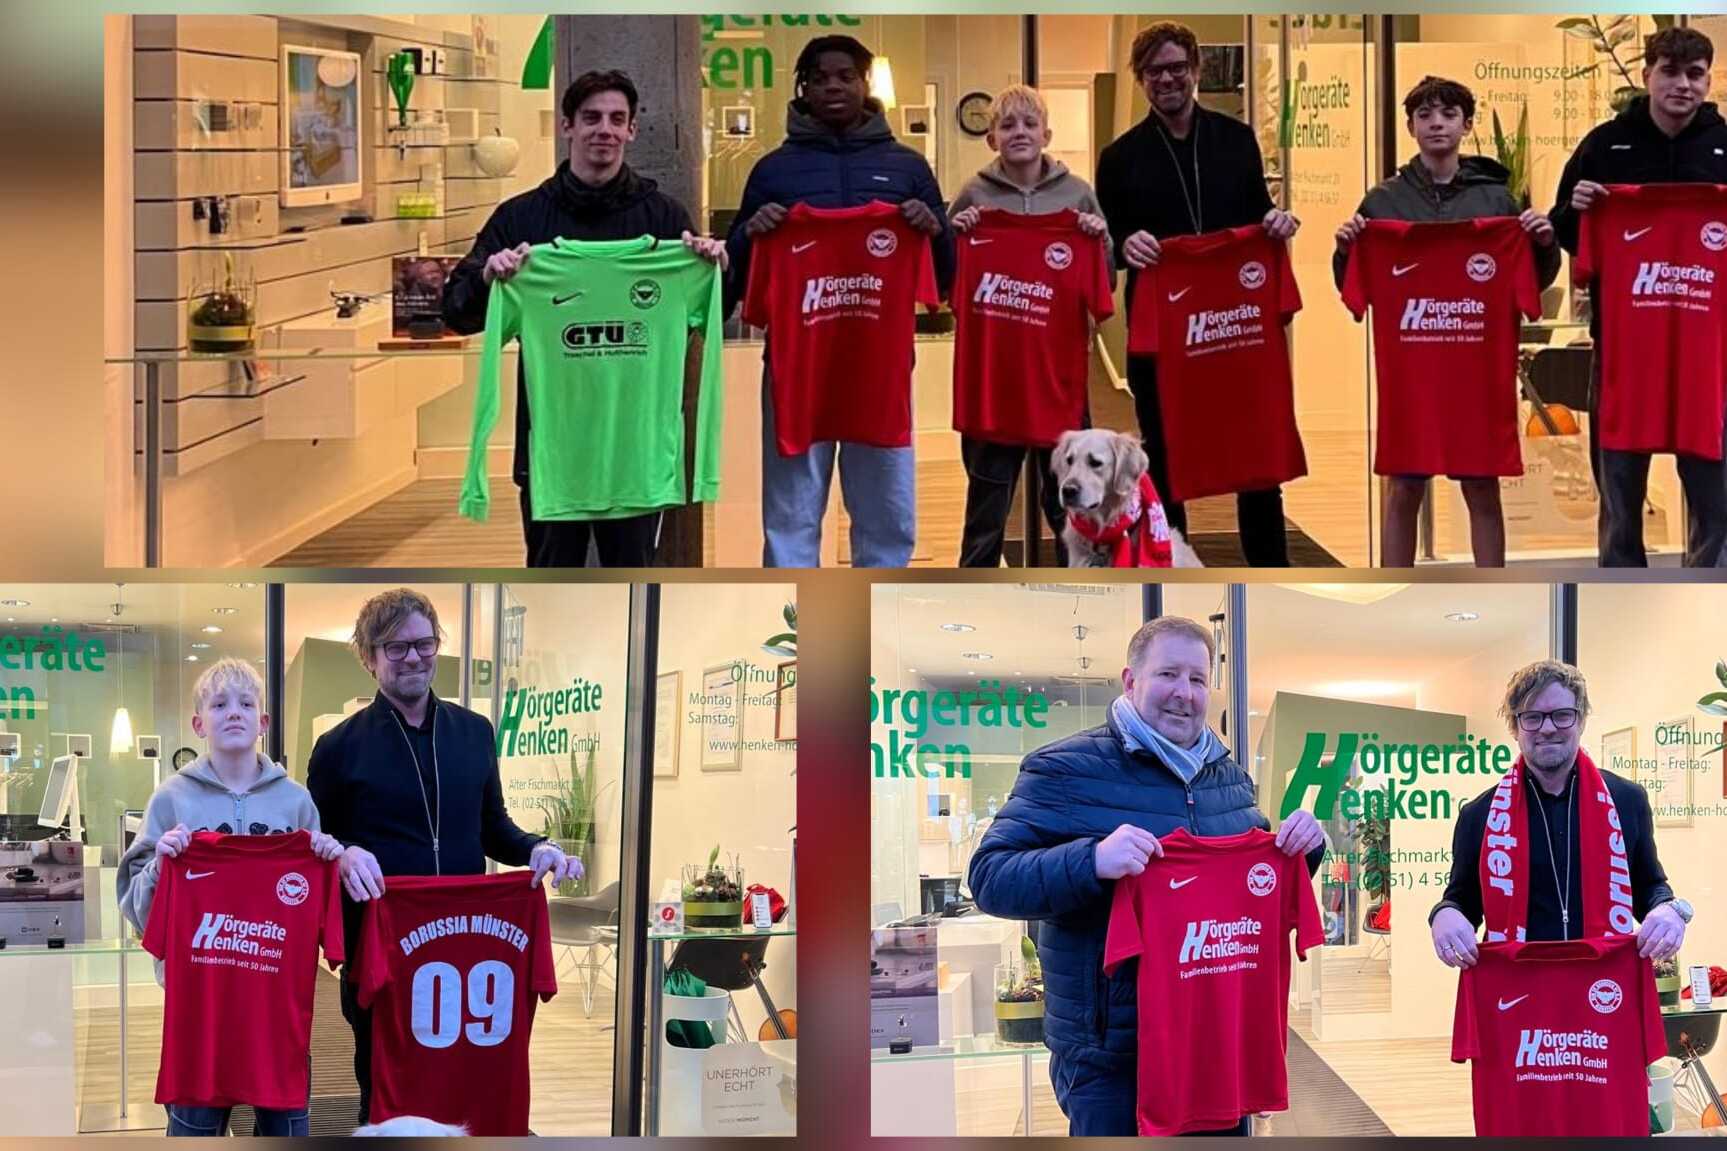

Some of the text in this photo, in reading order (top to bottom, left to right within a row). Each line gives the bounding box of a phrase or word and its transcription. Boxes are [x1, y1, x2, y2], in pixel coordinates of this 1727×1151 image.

[498, 678, 602, 736] Hörgeräte
[689, 692, 732, 708] Montag
[570, 733, 601, 753] GmbH
[1282, 732, 1511, 797] Hörgeräte
[1612, 756, 1658, 772] Montag
[1668, 756, 1712, 773] Freitag:
[193, 912, 287, 943] Hörgeräte
[400, 913, 529, 956] BORUSSIA MÜNSTER
[1181, 916, 1262, 948] Hörgeräte
[260, 946, 282, 959] GmbH
[411, 960, 515, 1049] 09
[1517, 1029, 1608, 1058] Hörgeräte
[1583, 1057, 1608, 1069] GmbH
[724, 1081, 755, 1093] ECHT
[1585, 1073, 1607, 1084] Jahren
